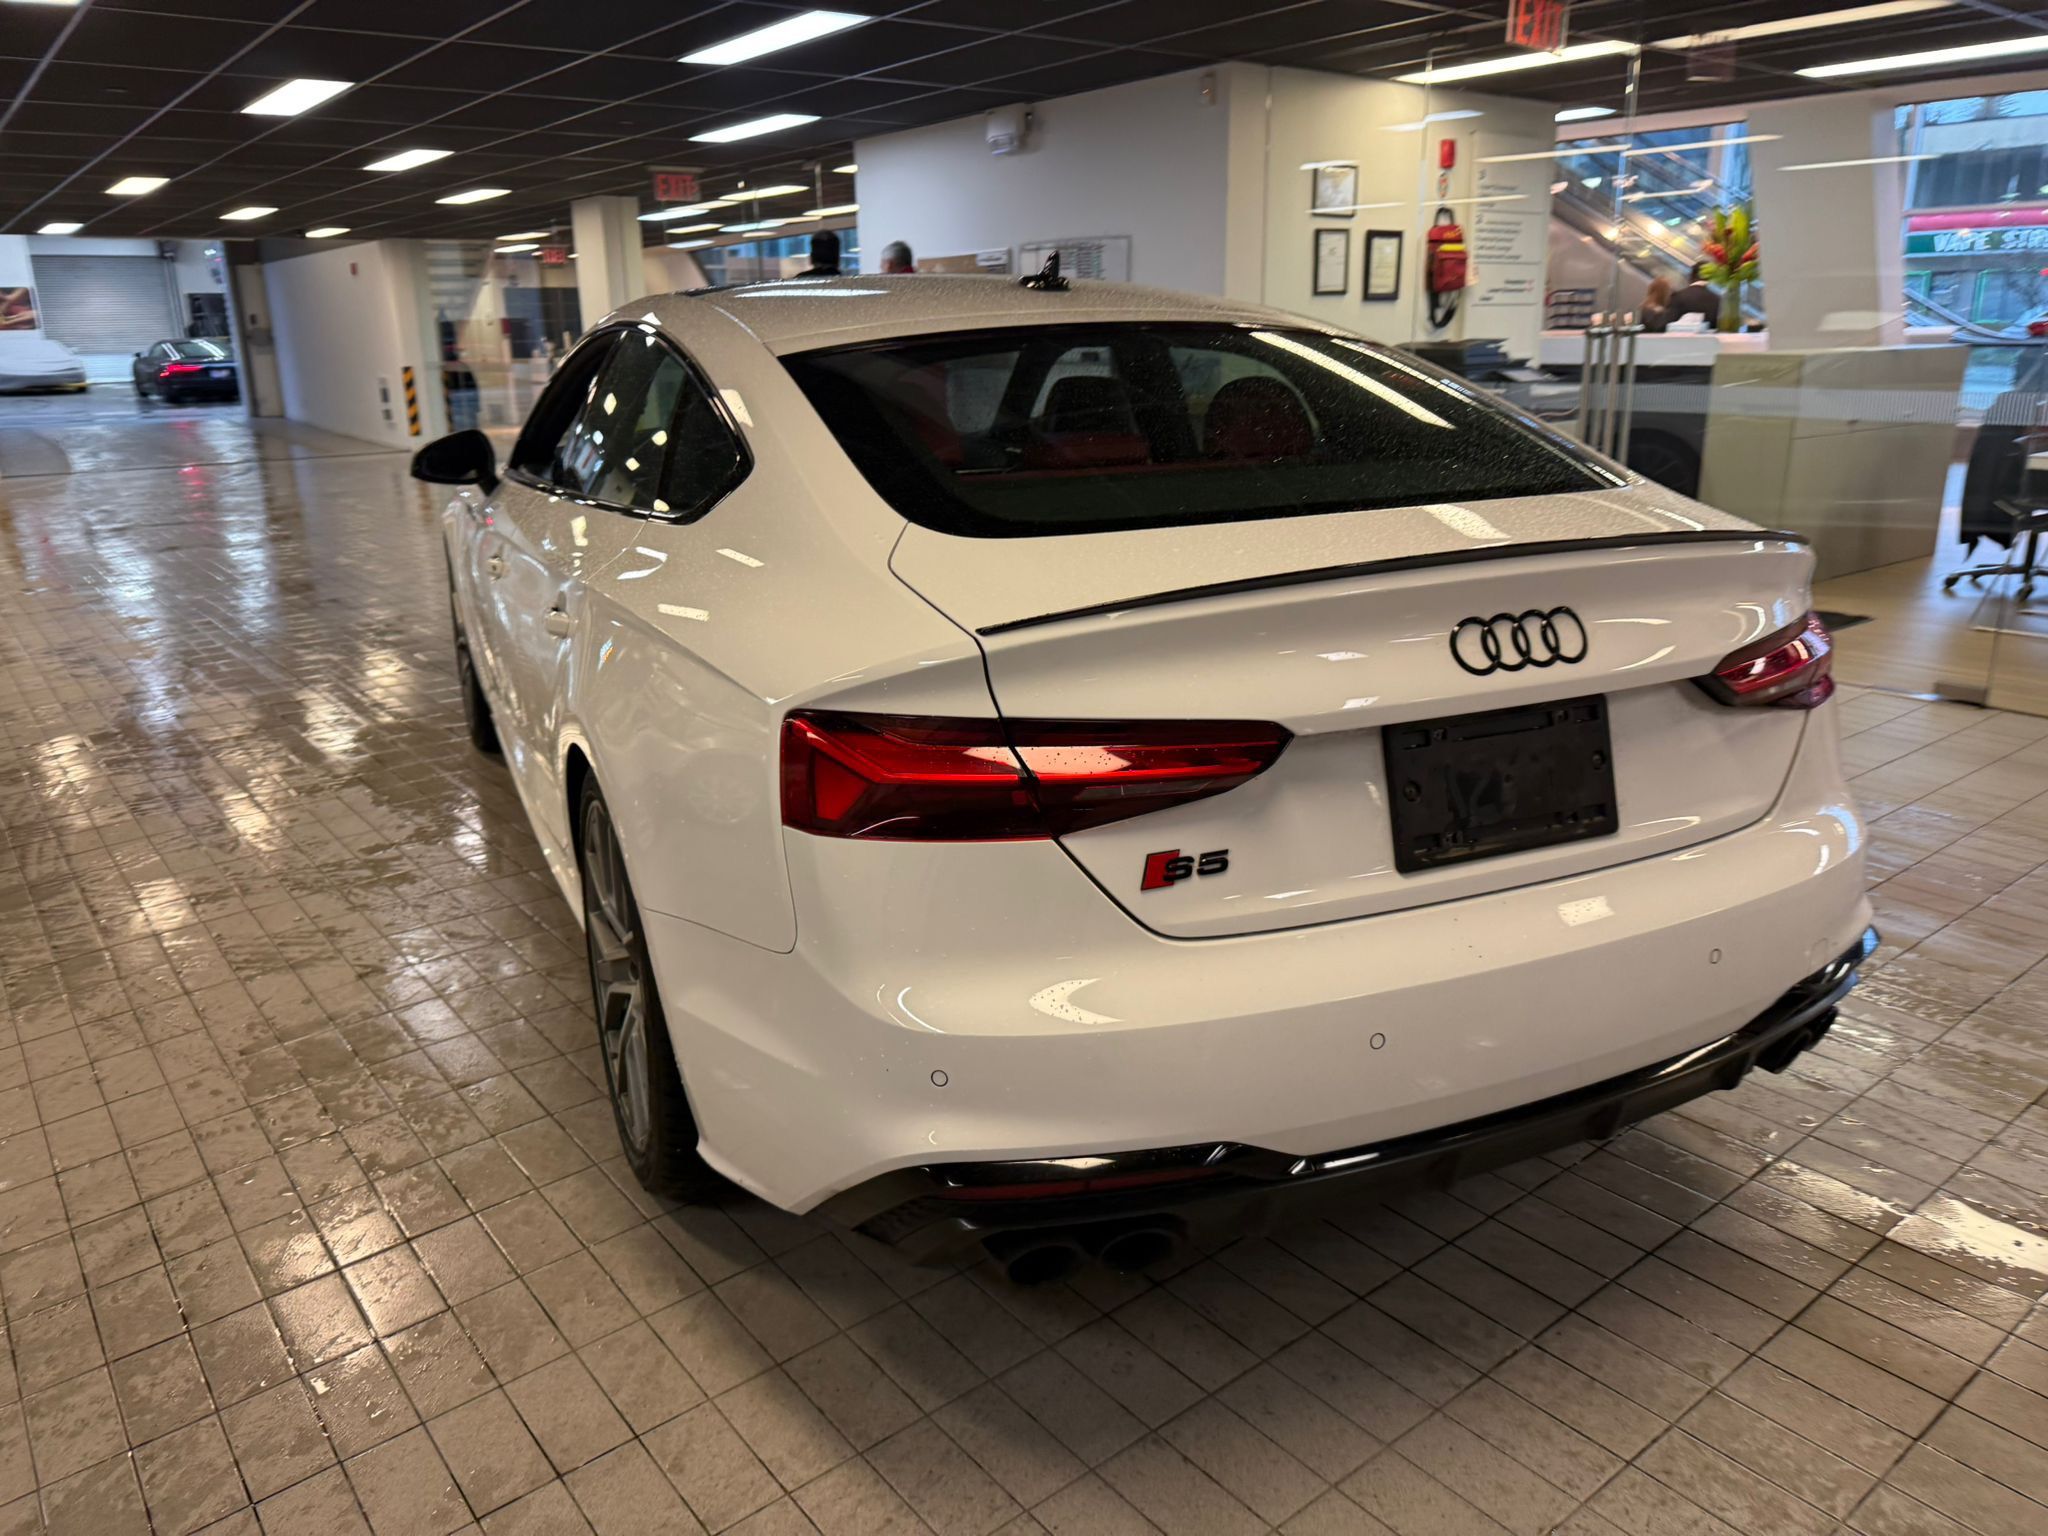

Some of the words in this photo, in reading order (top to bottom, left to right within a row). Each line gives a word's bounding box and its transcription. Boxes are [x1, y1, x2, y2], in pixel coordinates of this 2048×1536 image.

[1515, 0, 1564, 49] EXIT
[1933, 231, 1993, 252] VAPE
[1163, 849, 1229, 882] S5
